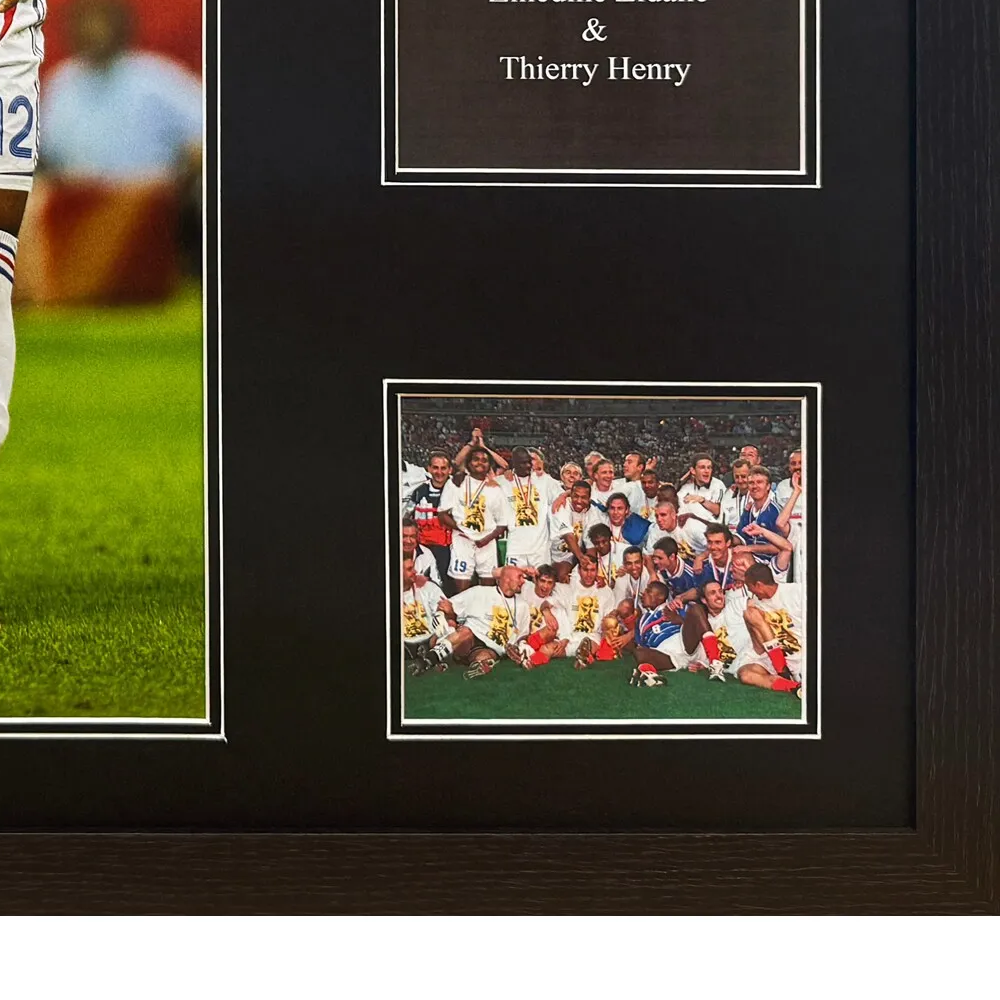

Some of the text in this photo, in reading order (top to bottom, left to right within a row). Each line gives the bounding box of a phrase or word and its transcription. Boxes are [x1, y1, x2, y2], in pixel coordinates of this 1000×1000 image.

[581, 17, 608, 42] &
[499, 55, 692, 87] Thierry Henry
[453, 559, 467, 573] 19
